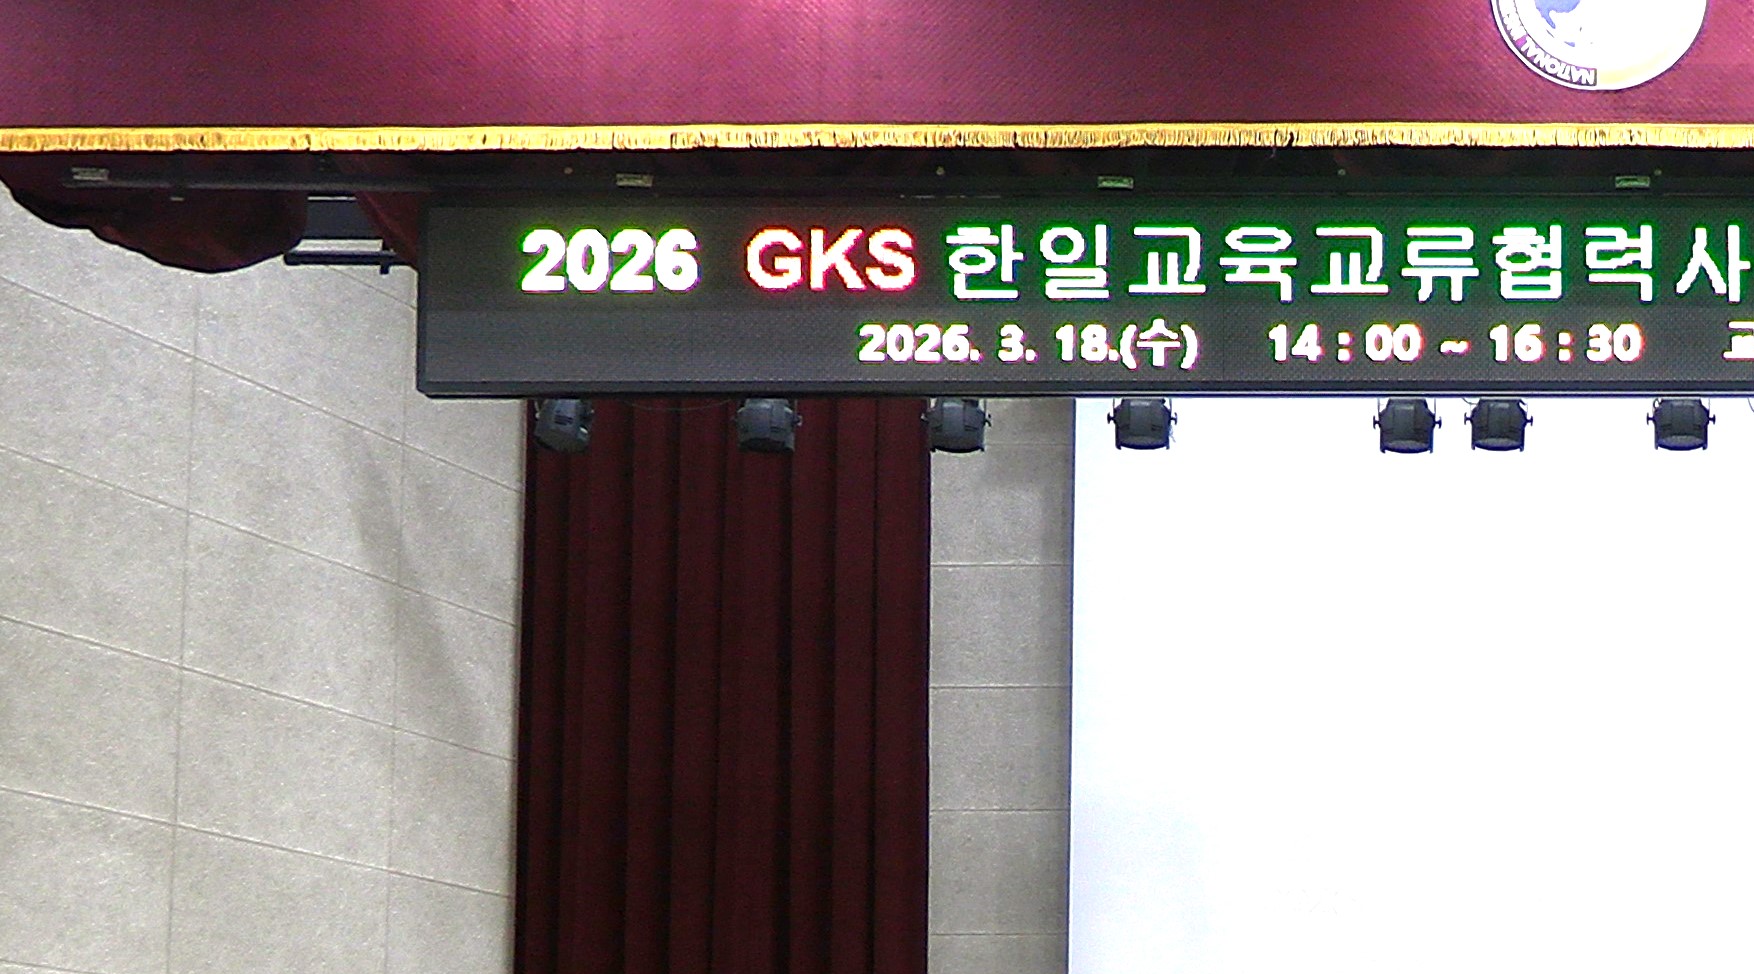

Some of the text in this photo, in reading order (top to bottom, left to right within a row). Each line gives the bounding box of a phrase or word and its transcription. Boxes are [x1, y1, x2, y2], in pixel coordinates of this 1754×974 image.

[1519, 36, 1596, 87] NATIONAL
[519, 226, 700, 294] 2026
[745, 227, 917, 292] GKS
[857, 322, 983, 364] 2026.
[996, 323, 1038, 363] 3.
[1054, 317, 1200, 371] 18.(수)
